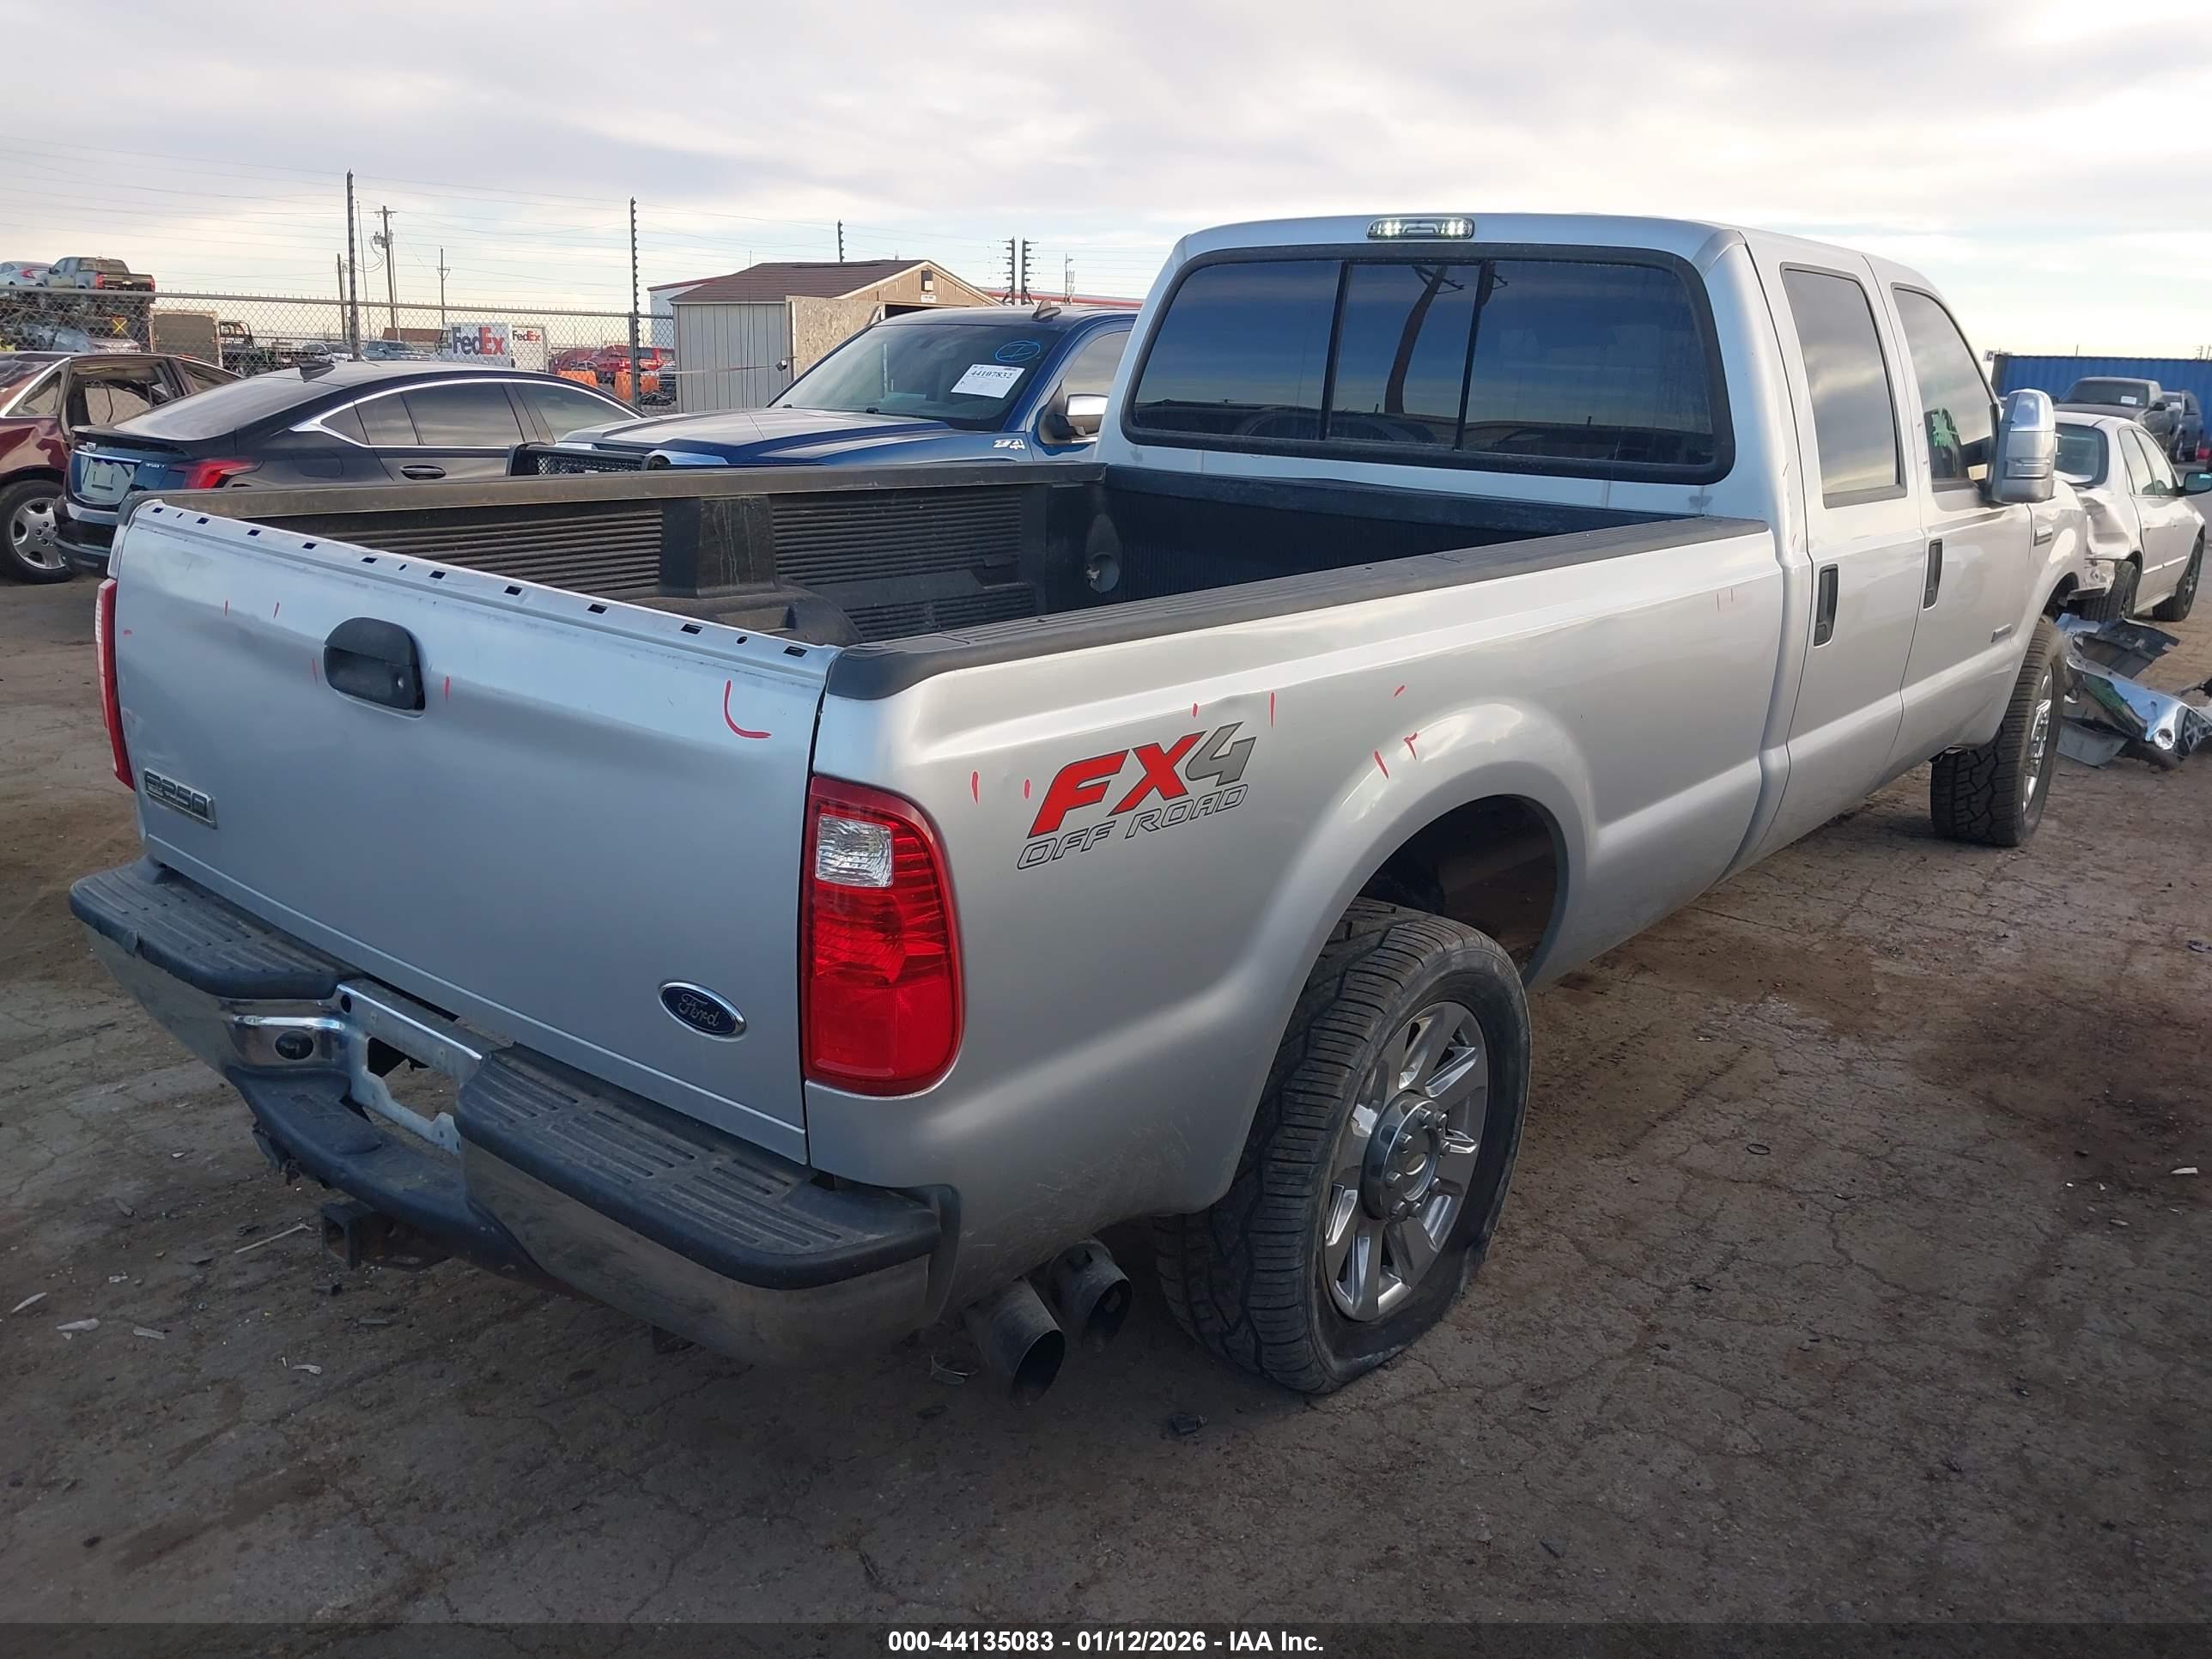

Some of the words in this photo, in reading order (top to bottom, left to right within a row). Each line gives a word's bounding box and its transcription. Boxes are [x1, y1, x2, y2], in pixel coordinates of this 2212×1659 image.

[452, 326, 505, 355] FedEx
[512, 330, 540, 342] FedEx
[1027, 721, 1256, 839] FX4
[1017, 820, 1116, 870] OFF
[1124, 784, 1249, 839] ROAD
[678, 994, 720, 1026] Ford
